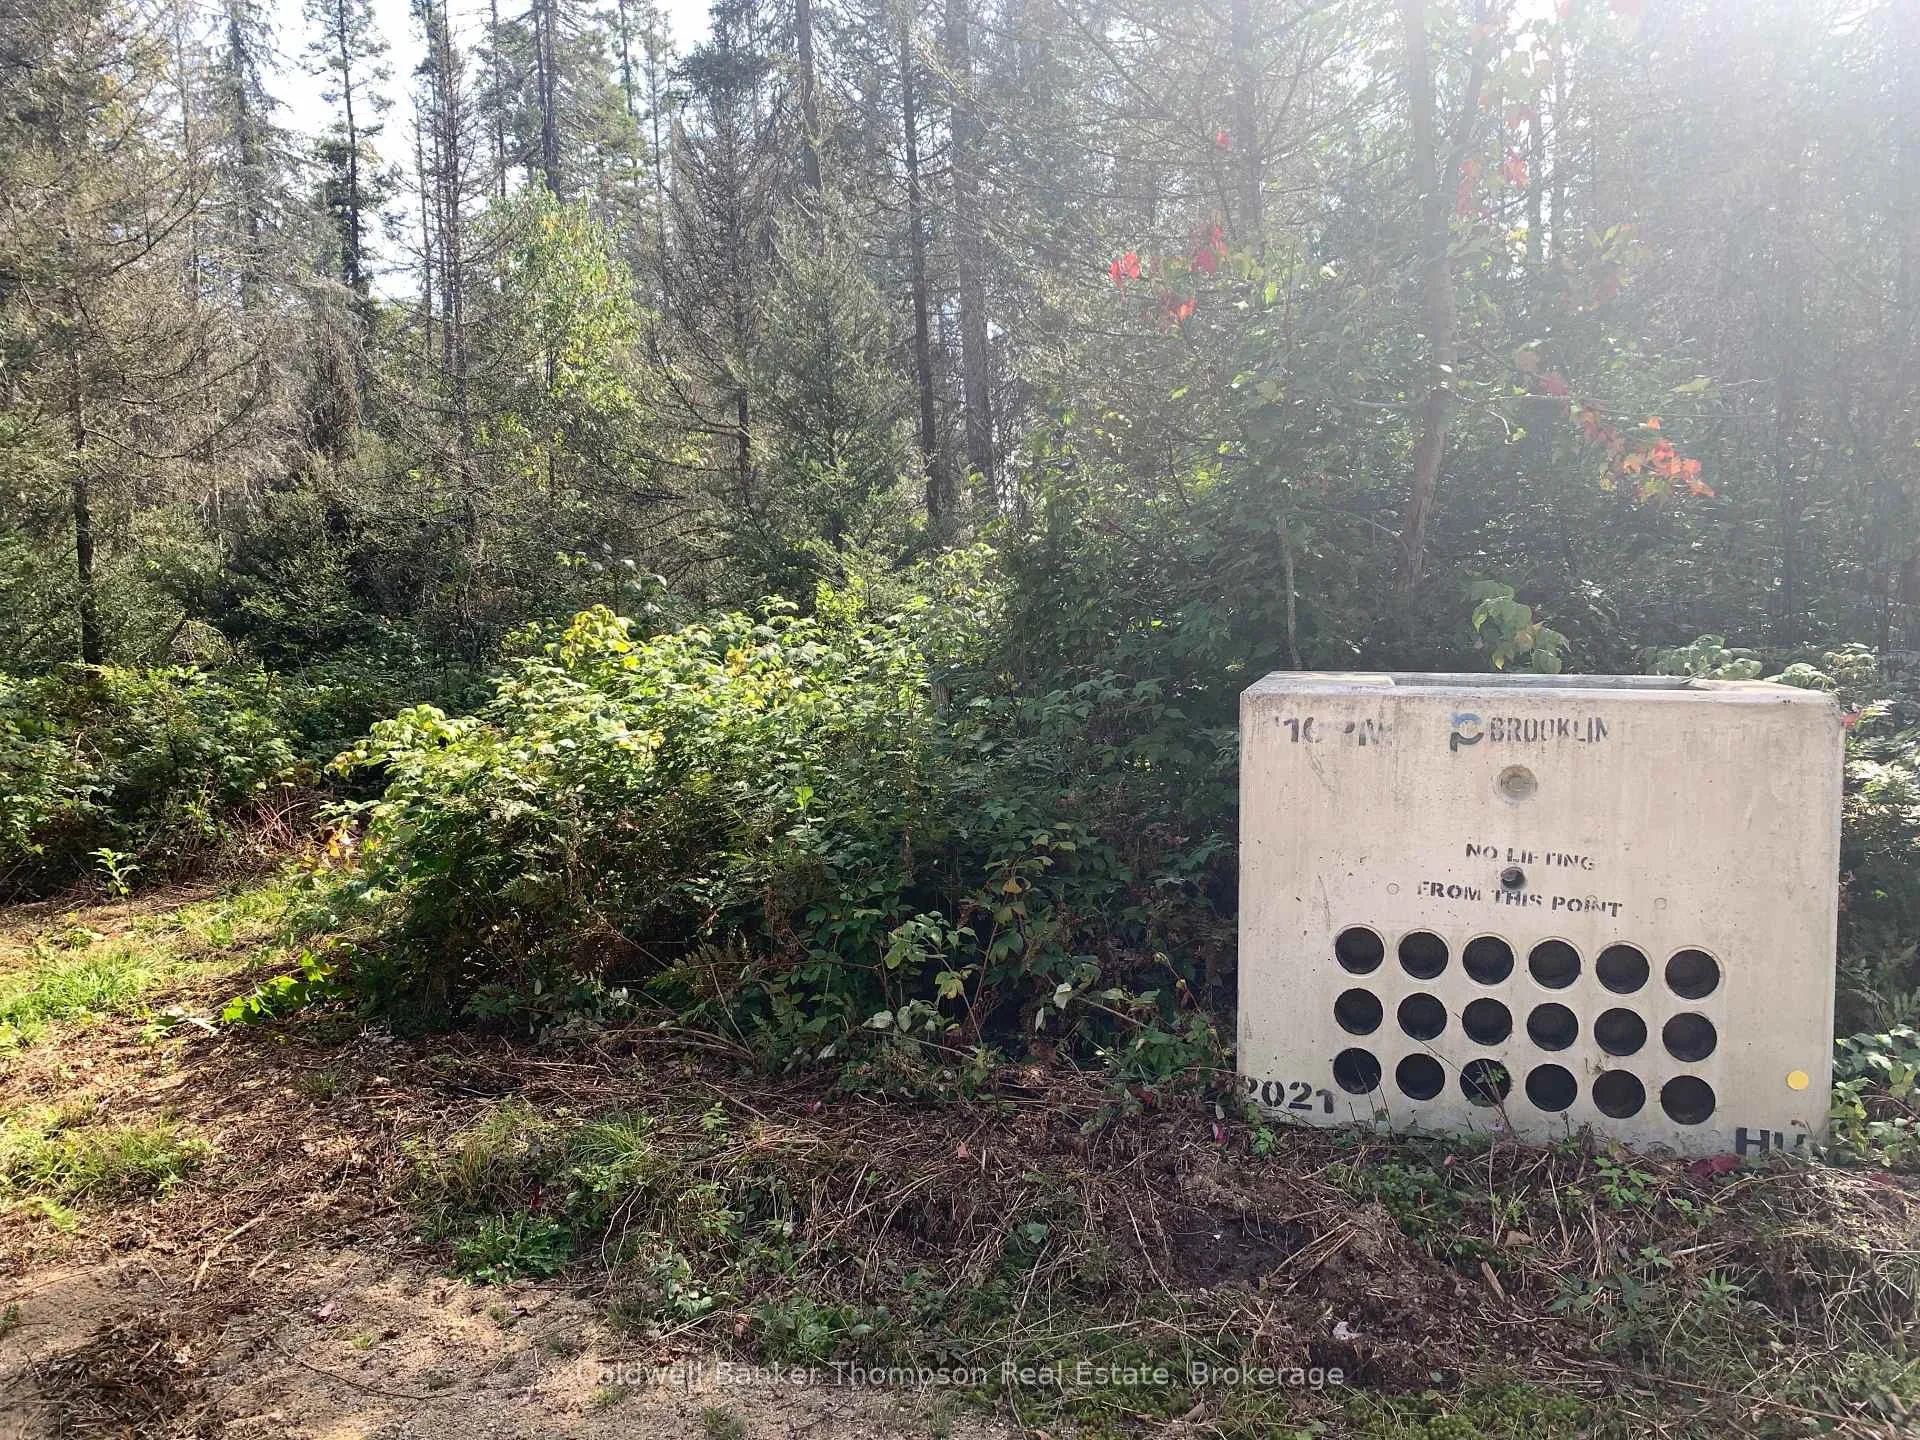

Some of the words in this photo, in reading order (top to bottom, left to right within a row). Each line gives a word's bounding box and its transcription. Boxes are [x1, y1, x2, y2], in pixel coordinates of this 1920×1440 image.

[1489, 716, 1608, 743] BROOKLIN
[1465, 843, 1498, 860] NO
[1506, 847, 1595, 871] LIFTING
[1417, 880, 1481, 901] FROM
[1494, 887, 1543, 907] THIS
[1551, 895, 1623, 918] POINT
